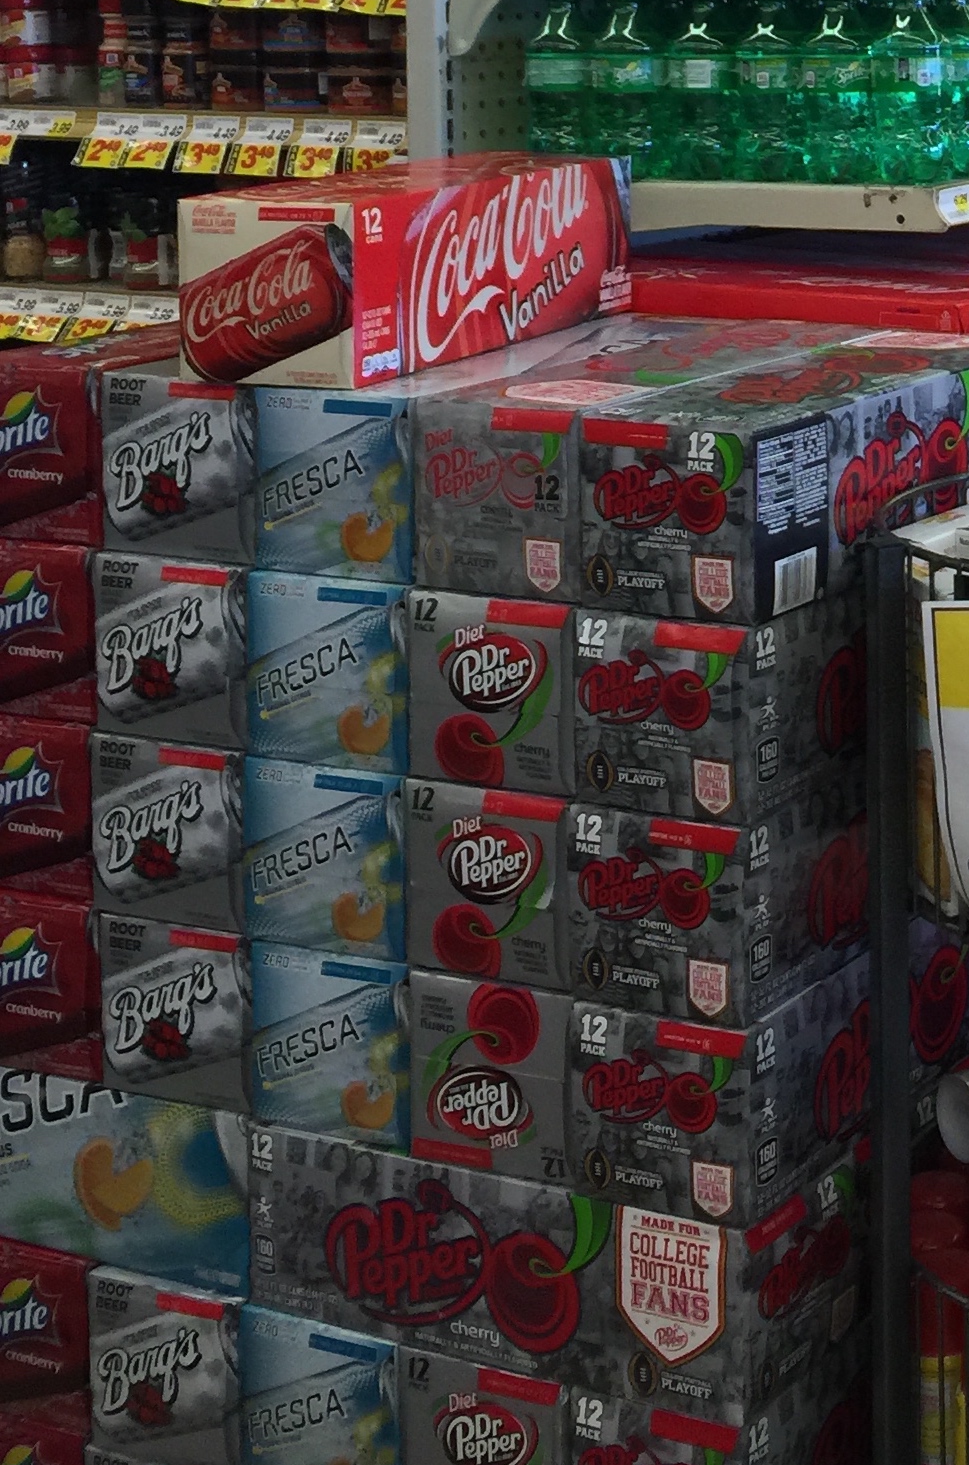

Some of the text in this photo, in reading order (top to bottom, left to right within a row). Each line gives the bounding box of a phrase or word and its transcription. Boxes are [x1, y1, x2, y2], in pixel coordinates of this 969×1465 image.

[361, 208, 382, 234] 12
[419, 162, 588, 362] Coca-Cola
[187, 240, 313, 342] Coca-Cola
[500, 243, 585, 341] Vanilla
[245, 301, 312, 340] Vanilla
[110, 379, 145, 391] ROOT
[110, 392, 141, 406] BEER
[424, 428, 452, 451] Diet
[687, 431, 716, 459] 12
[109, 411, 211, 511] Barq's
[687, 460, 714, 472] PACK
[7, 468, 63, 484] cranberry
[262, 450, 365, 518] FRESCA
[431, 452, 495, 498] Pepper
[534, 476, 560, 500] 12
[654, 526, 688, 539] cherry
[102, 561, 138, 573] ROOT
[102, 574, 133, 589] BEER
[618, 575, 665, 590] PLAYOFF
[414, 598, 437, 621] 12
[454, 624, 485, 648] Diet
[578, 617, 606, 647] 12
[755, 627, 776, 658] 12
[8, 645, 64, 663] cranberry
[102, 596, 203, 694] Barq's
[578, 647, 603, 659] PACK
[482, 644, 510, 671] Dr
[756, 654, 776, 670] PACK
[256, 637, 357, 704] FRESCA
[457, 649, 531, 697] Pepper
[640, 720, 674, 735] cherry
[100, 742, 135, 755] ROOT
[100, 756, 131, 770] BEER
[618, 773, 666, 788] PLAYOFF
[411, 787, 434, 811] 12
[8, 821, 63, 839] cranberry
[101, 780, 203, 873] Barq's
[452, 815, 481, 837] Diet
[575, 813, 602, 841] 12
[478, 836, 507, 861] Dr
[576, 841, 601, 855] PACK
[750, 826, 768, 858] 12
[252, 826, 354, 891] FRESCA
[460, 840, 527, 887] Pepper
[750, 853, 769, 870] PACK
[110, 922, 145, 935] ROOT
[639, 917, 672, 934] cherry
[110, 938, 141, 951] BEER
[613, 971, 660, 989] PLAYOFF
[6, 1002, 61, 1022] cranberry
[110, 963, 214, 1054] Barq's
[581, 1014, 607, 1043] 12
[258, 1014, 359, 1076] FRESCA
[580, 1043, 606, 1056] PACK
[756, 1028, 776, 1059] 12
[756, 1054, 776, 1074] PACK
[643, 1120, 676, 1138] cherry
[252, 1132, 273, 1160] 12
[253, 1159, 272, 1172] PACK
[615, 1171, 664, 1190] PLAYOFF
[378, 1197, 442, 1253] Dr
[641, 1215, 701, 1236] MADE FOR
[342, 1210, 478, 1307] Pepper
[629, 1233, 709, 1270] COLLEGE
[631, 1258, 709, 1294] FOOTBALL
[97, 1281, 133, 1297] ROOT
[96, 1297, 128, 1313] BEER
[631, 1285, 711, 1323] FANS
[450, 1318, 500, 1348] cherry
[99, 1326, 202, 1415] Barq's
[408, 1357, 429, 1381] 12
[662, 1379, 712, 1399] PLAYOFF
[248, 1388, 345, 1441] FRESCA
[449, 1393, 478, 1413] Diet
[576, 1397, 603, 1429] 12
[475, 1414, 502, 1437] Dr
[576, 1426, 601, 1441] PACK
[455, 1416, 521, 1465] Pepper
